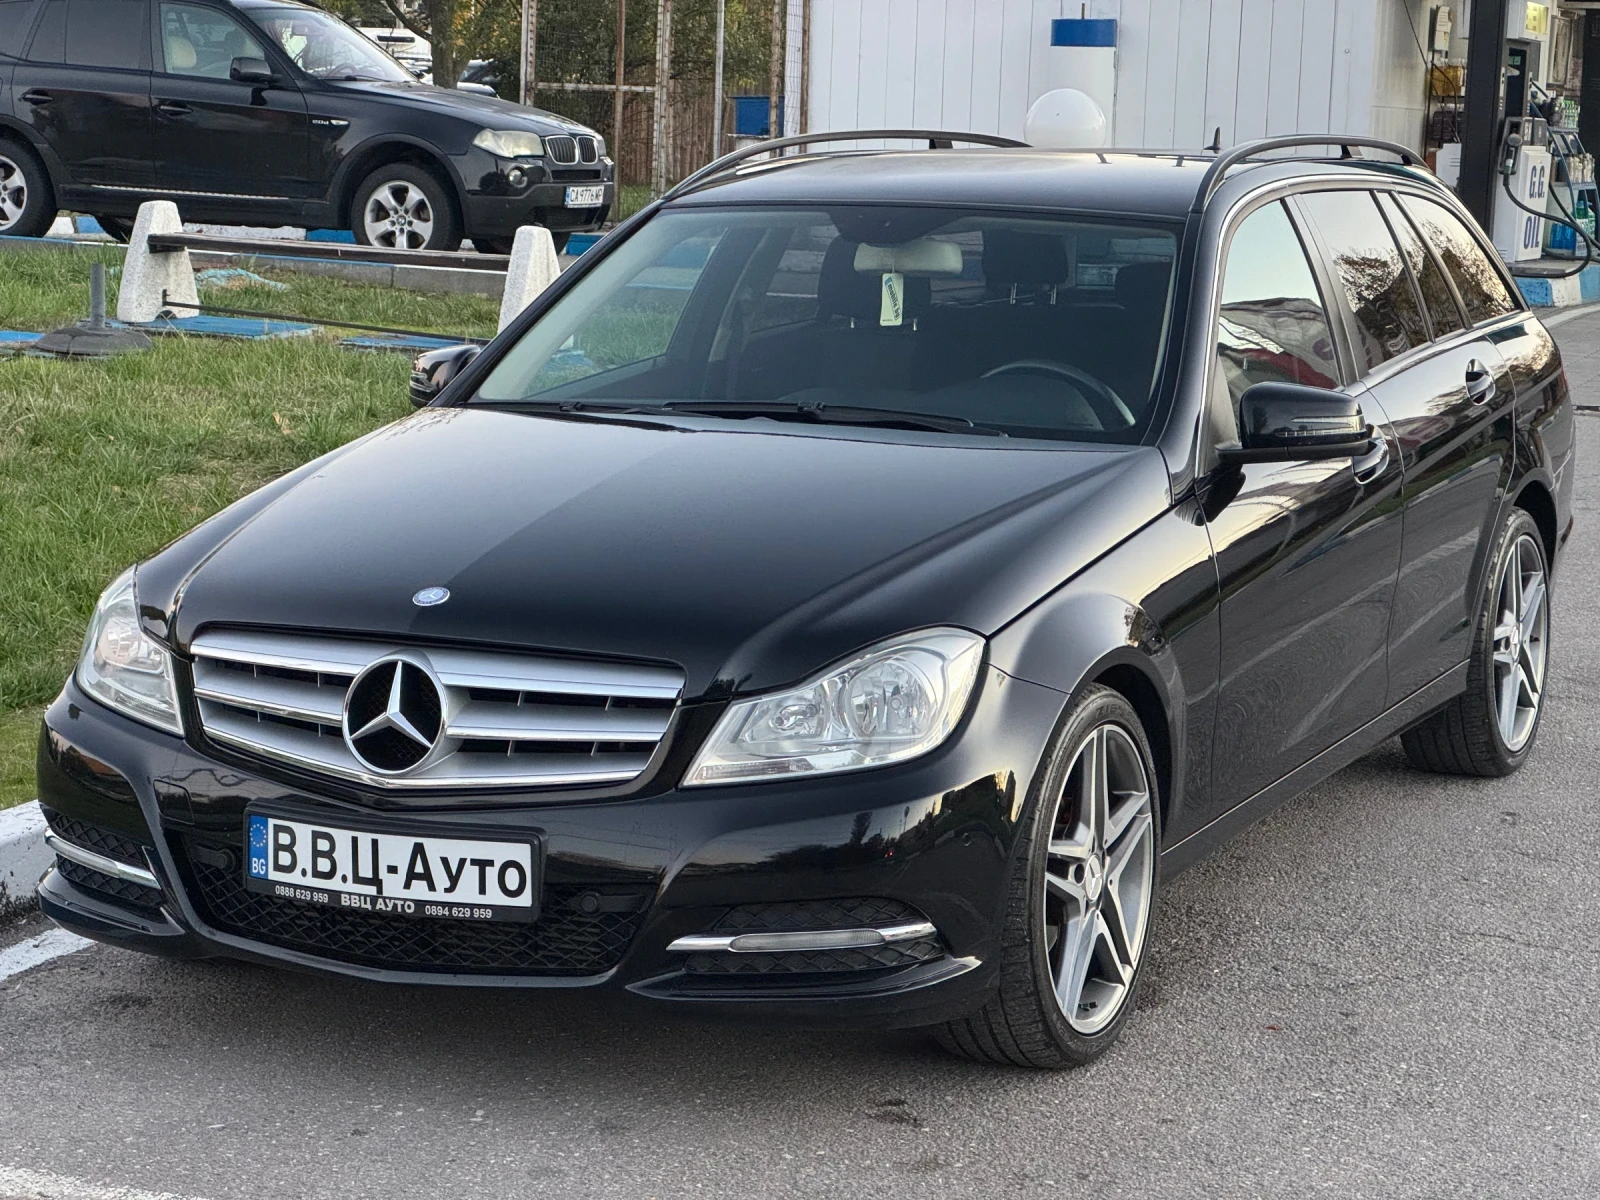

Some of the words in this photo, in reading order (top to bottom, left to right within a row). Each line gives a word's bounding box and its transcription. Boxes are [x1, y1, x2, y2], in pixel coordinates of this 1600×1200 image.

[1523, 215, 1541, 250] OIL
[252, 858, 266, 874] BG
[275, 885, 295, 898] 0888
[295, 889, 311, 901] 629
[312, 893, 329, 903] 959
[340, 894, 372, 911] ВВЦ
[375, 898, 415, 913] АУТО
[425, 905, 450, 917] 0894
[451, 907, 471, 918] 629
[473, 908, 493, 919] 959
